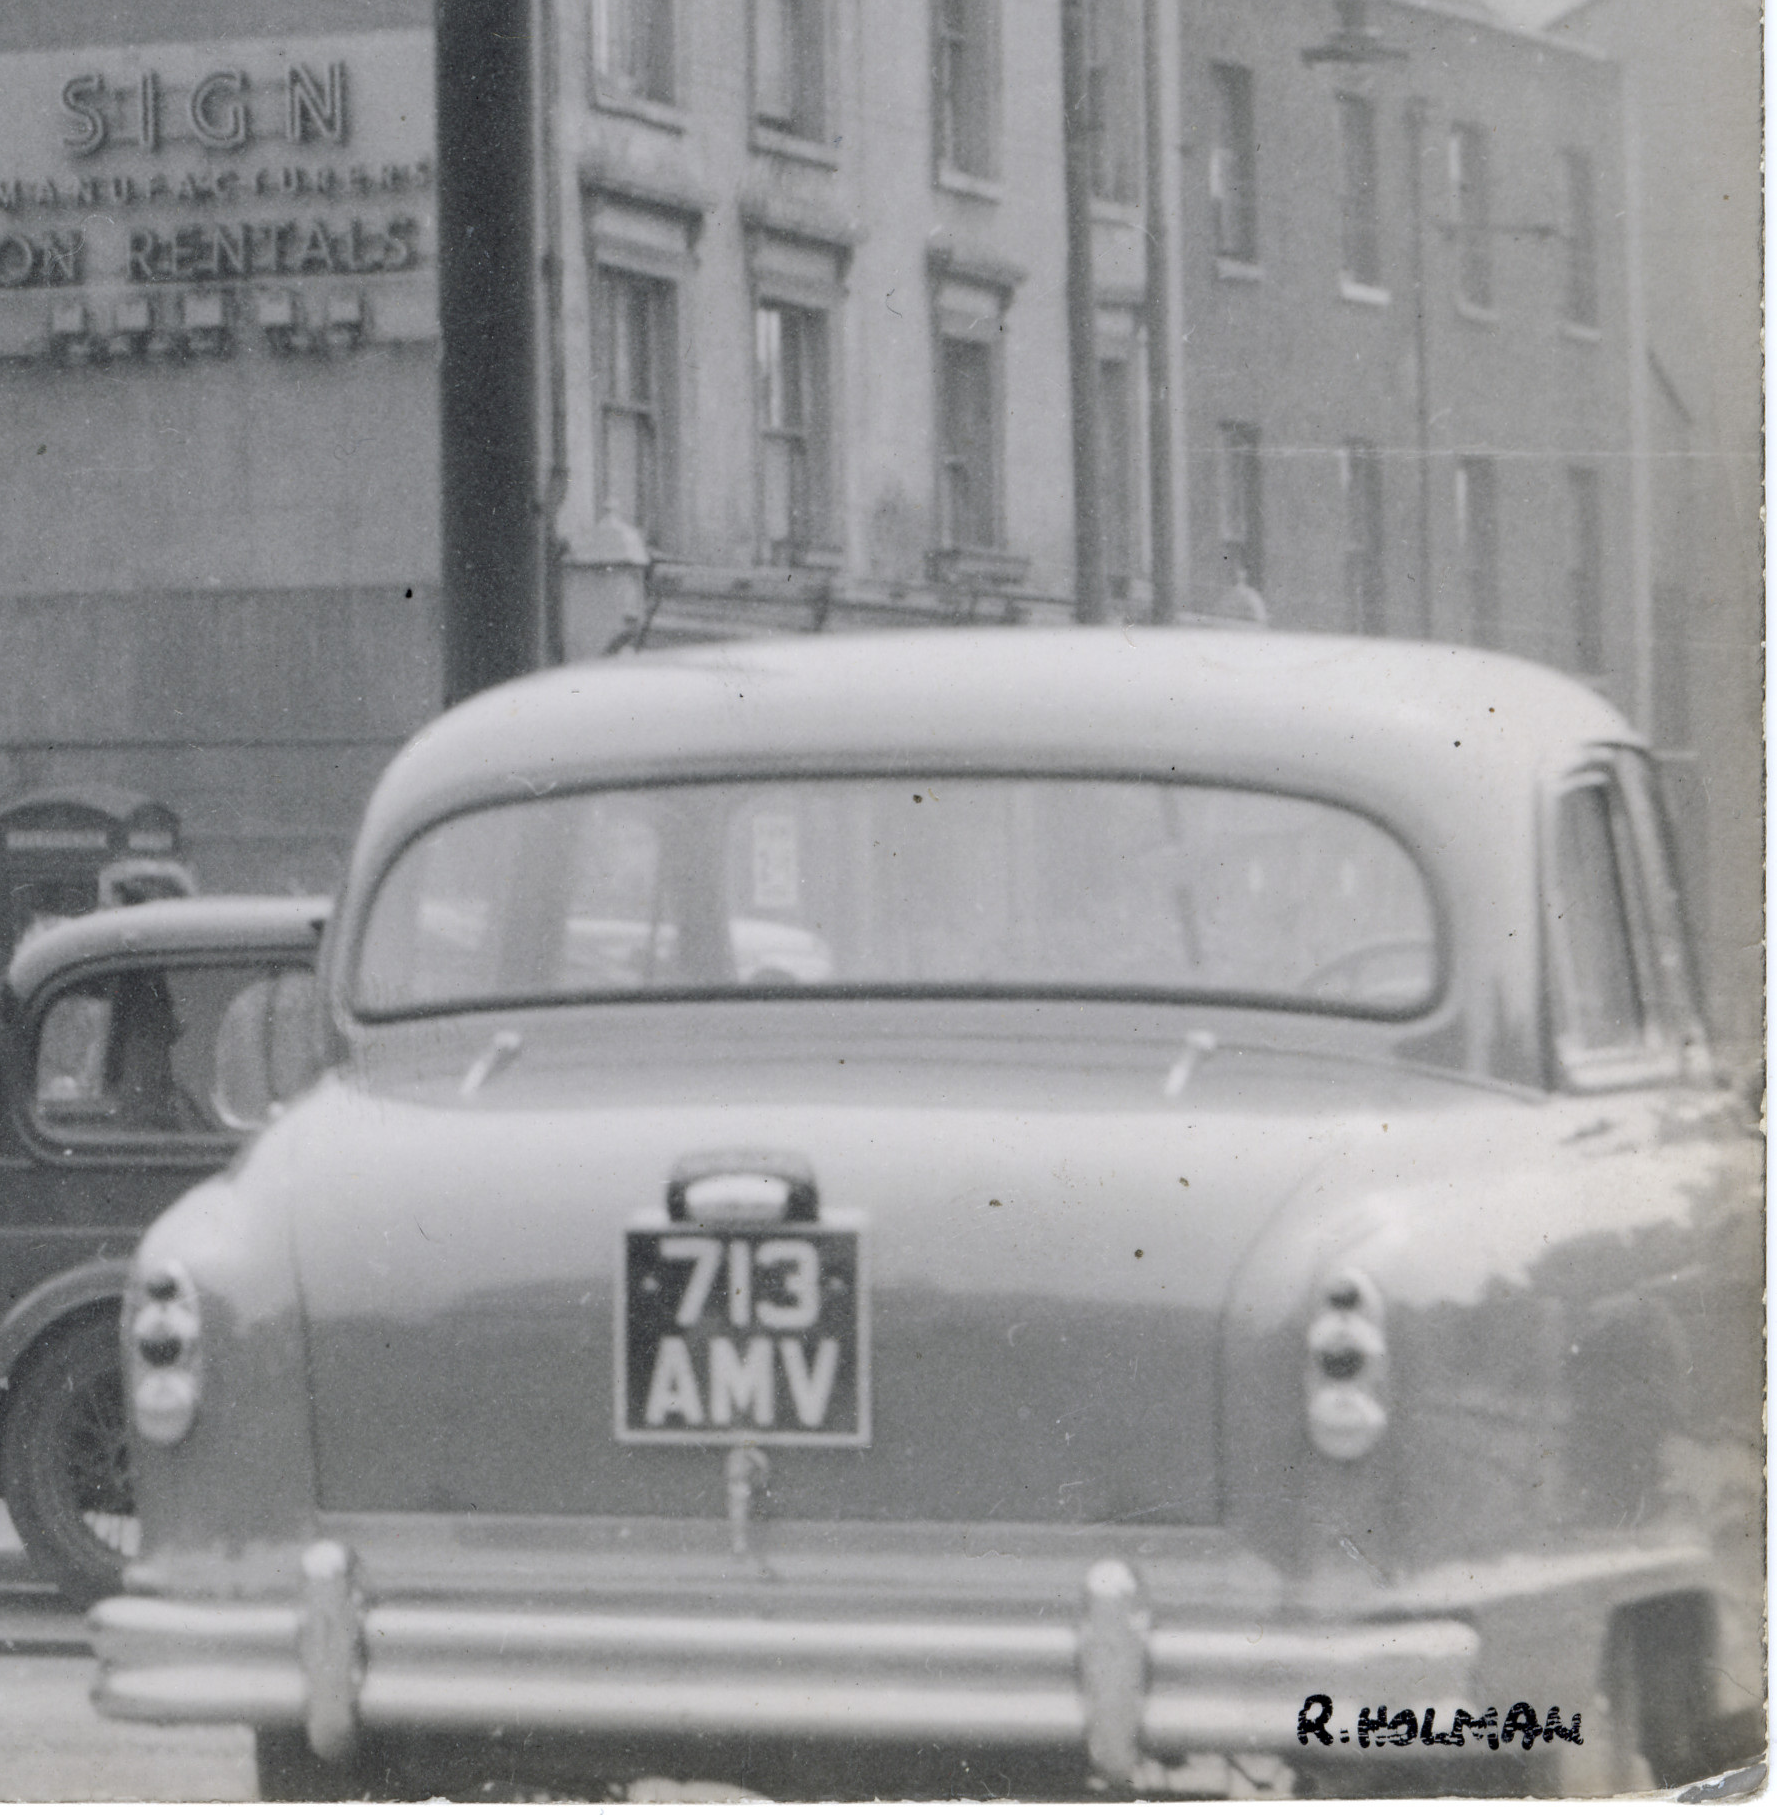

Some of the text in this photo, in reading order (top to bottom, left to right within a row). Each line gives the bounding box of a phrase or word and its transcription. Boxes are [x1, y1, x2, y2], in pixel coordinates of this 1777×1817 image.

[59, 61, 349, 155] SIGN
[127, 215, 419, 283] RENTALS
[659, 1237, 819, 1329] 713
[646, 1337, 840, 1426] AMV
